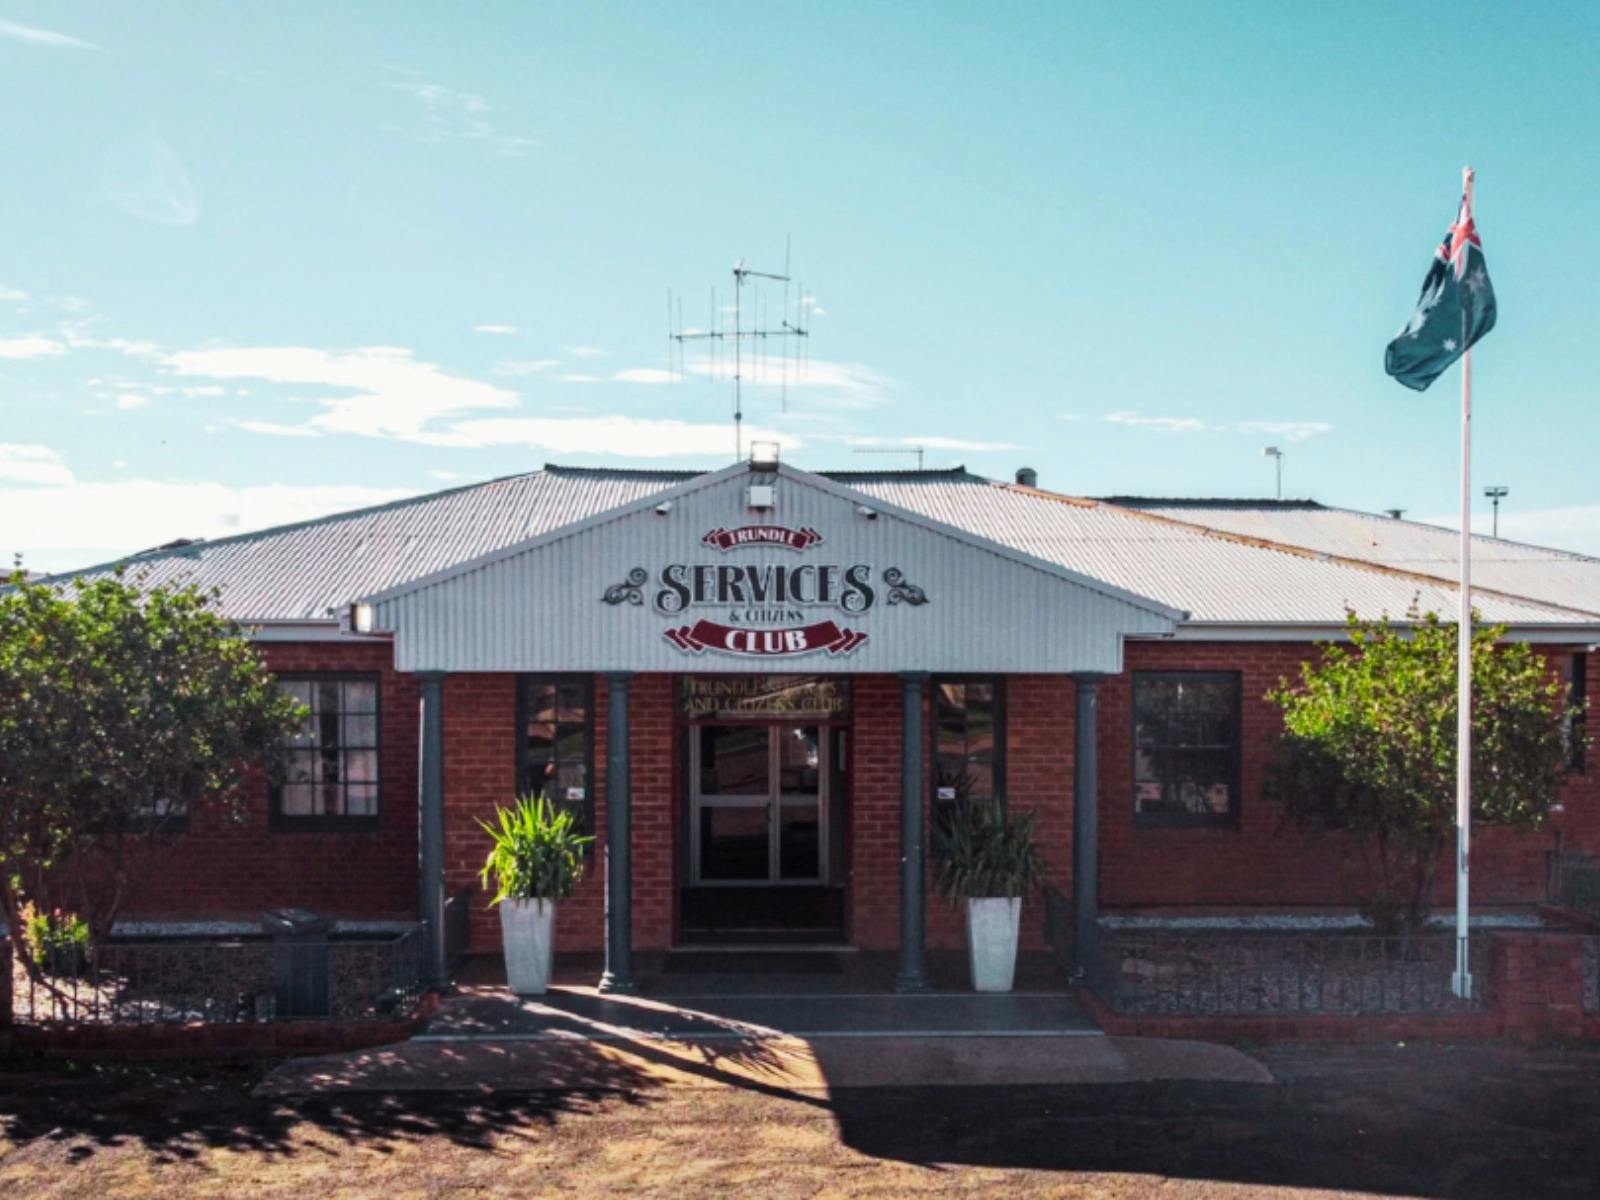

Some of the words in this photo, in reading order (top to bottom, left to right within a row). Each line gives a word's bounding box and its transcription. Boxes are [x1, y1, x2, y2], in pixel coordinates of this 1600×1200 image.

[728, 526, 796, 545] TRUNDLE
[656, 564, 874, 612] SERVICES
[728, 610, 740, 622] &
[745, 609, 805, 622] CITIZENS
[724, 629, 808, 653] CLUB
[684, 697, 720, 713] AND
